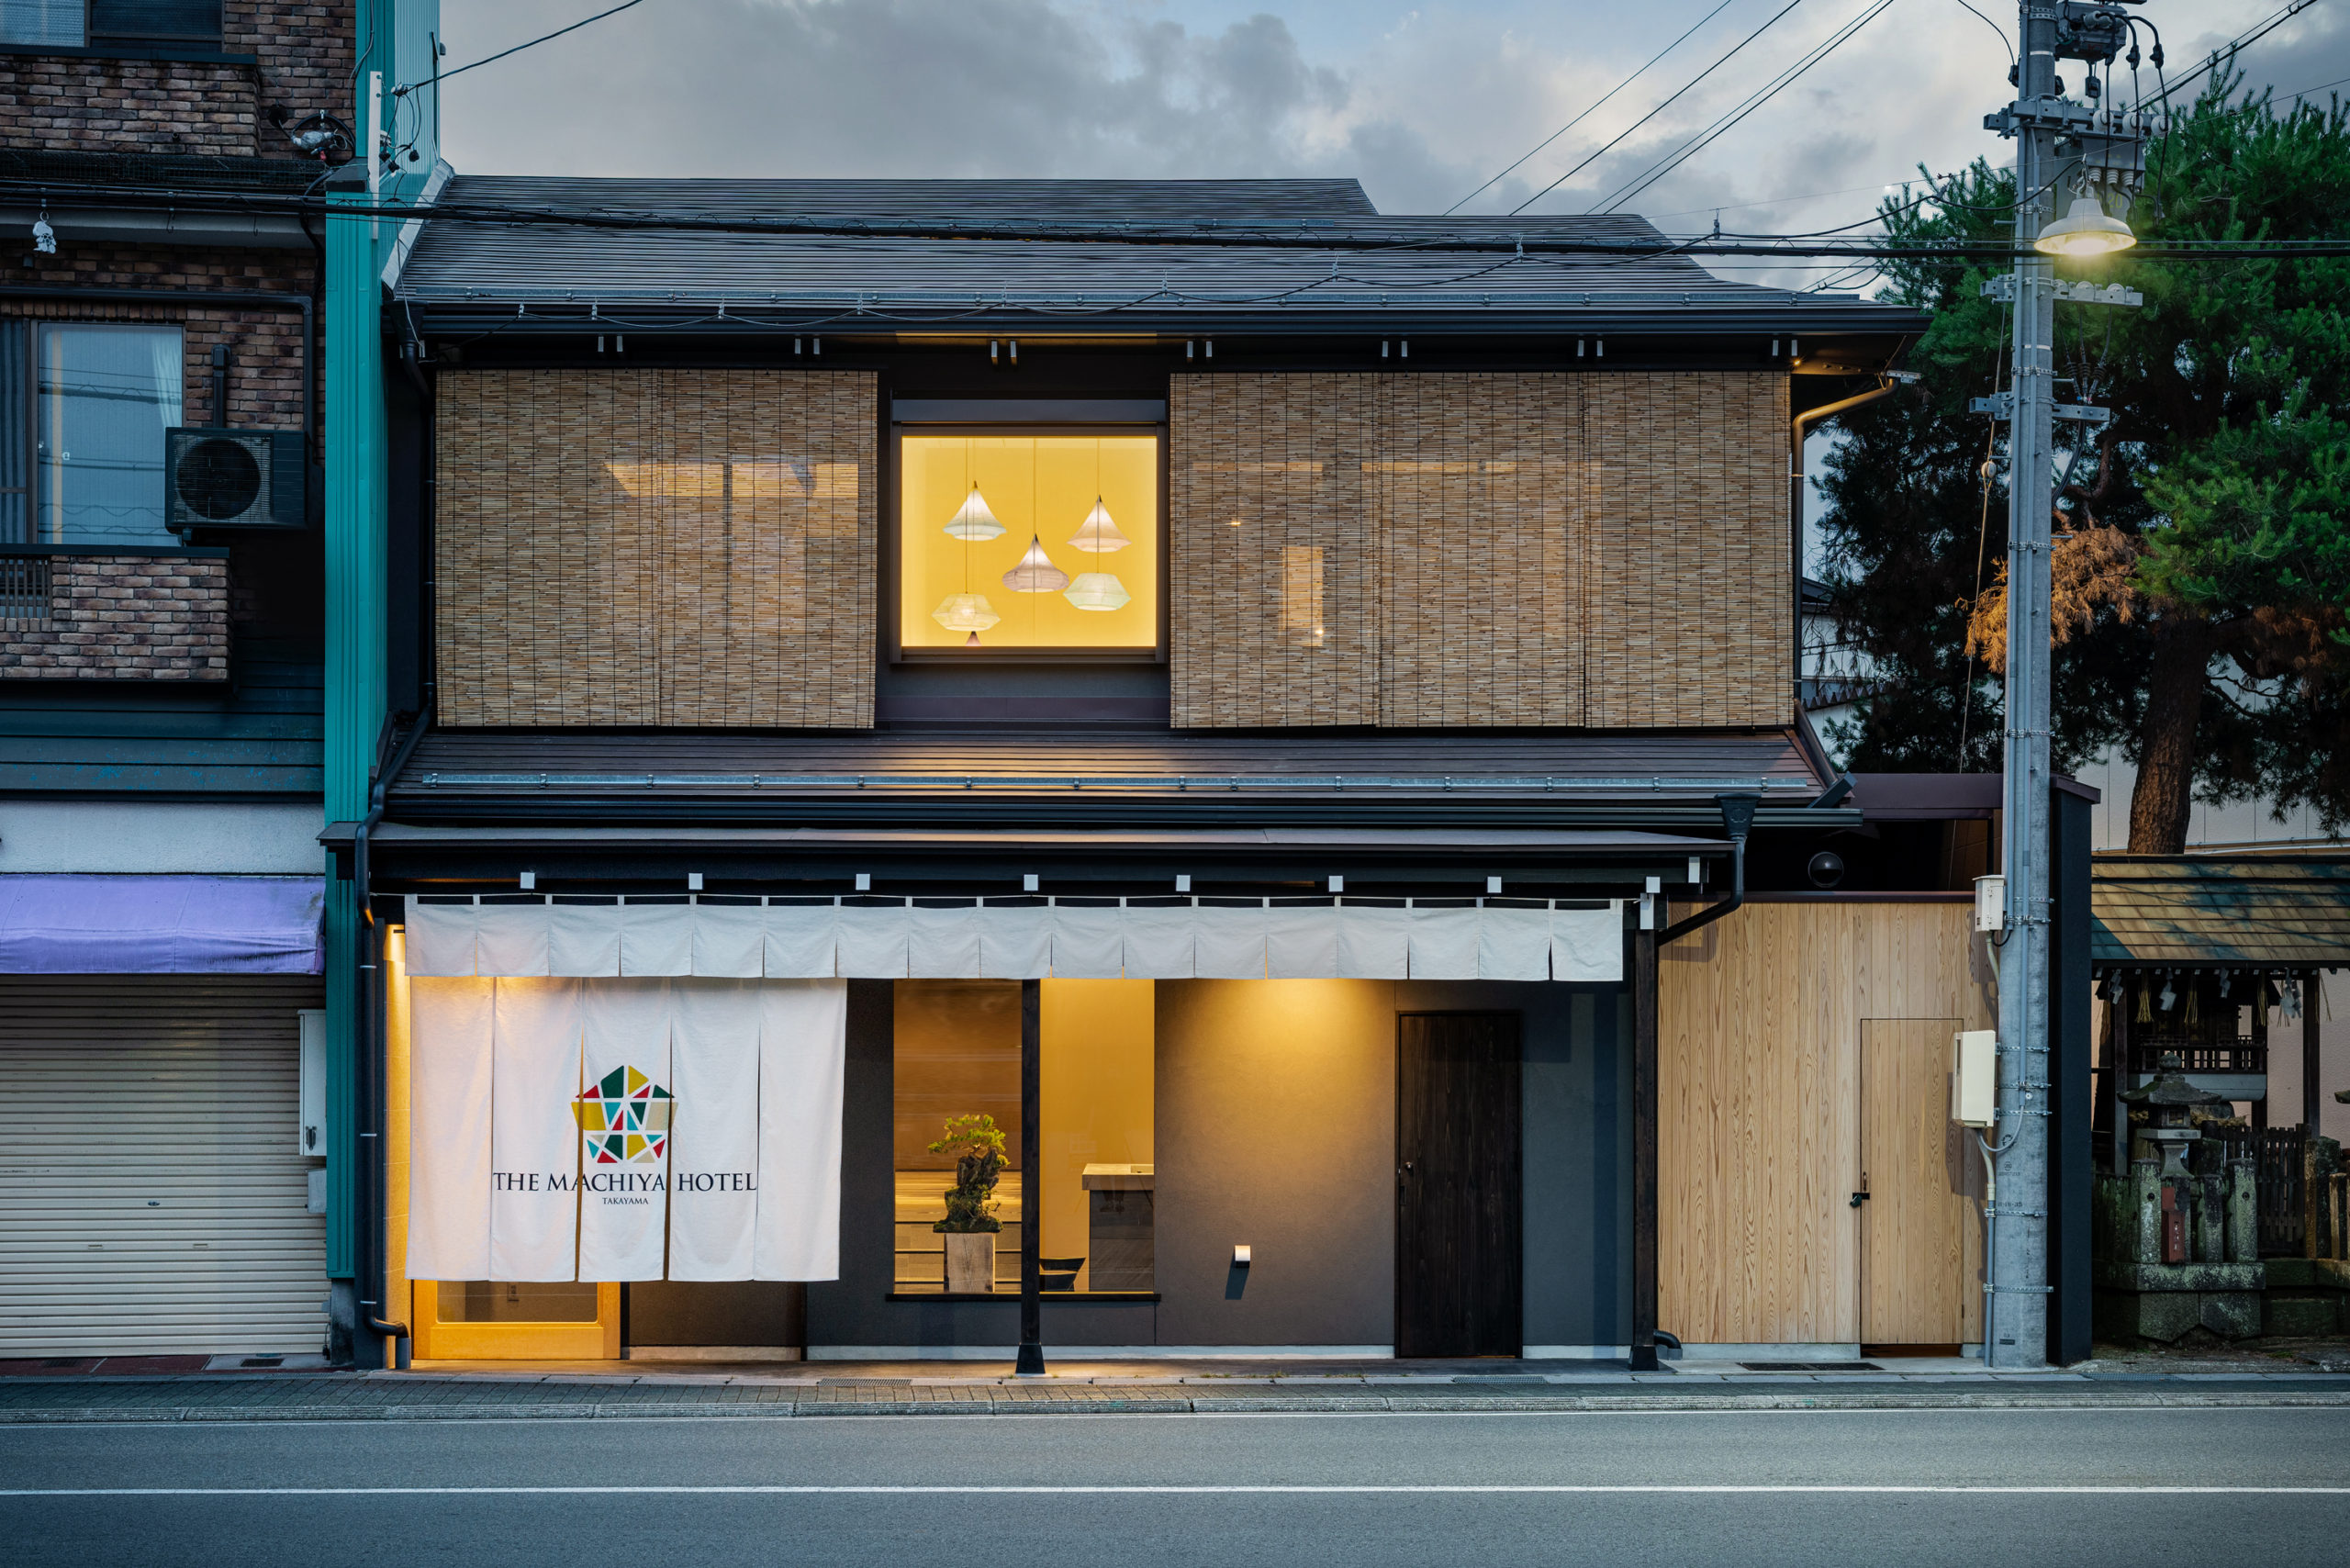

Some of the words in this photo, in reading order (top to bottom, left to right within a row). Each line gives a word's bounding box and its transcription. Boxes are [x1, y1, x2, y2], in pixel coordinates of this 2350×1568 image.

[493, 1172, 540, 1192] THE
[546, 1172, 666, 1193] MACHIYA
[677, 1172, 757, 1193] HOTEL
[602, 1197, 649, 1206] TAKAYAMA
